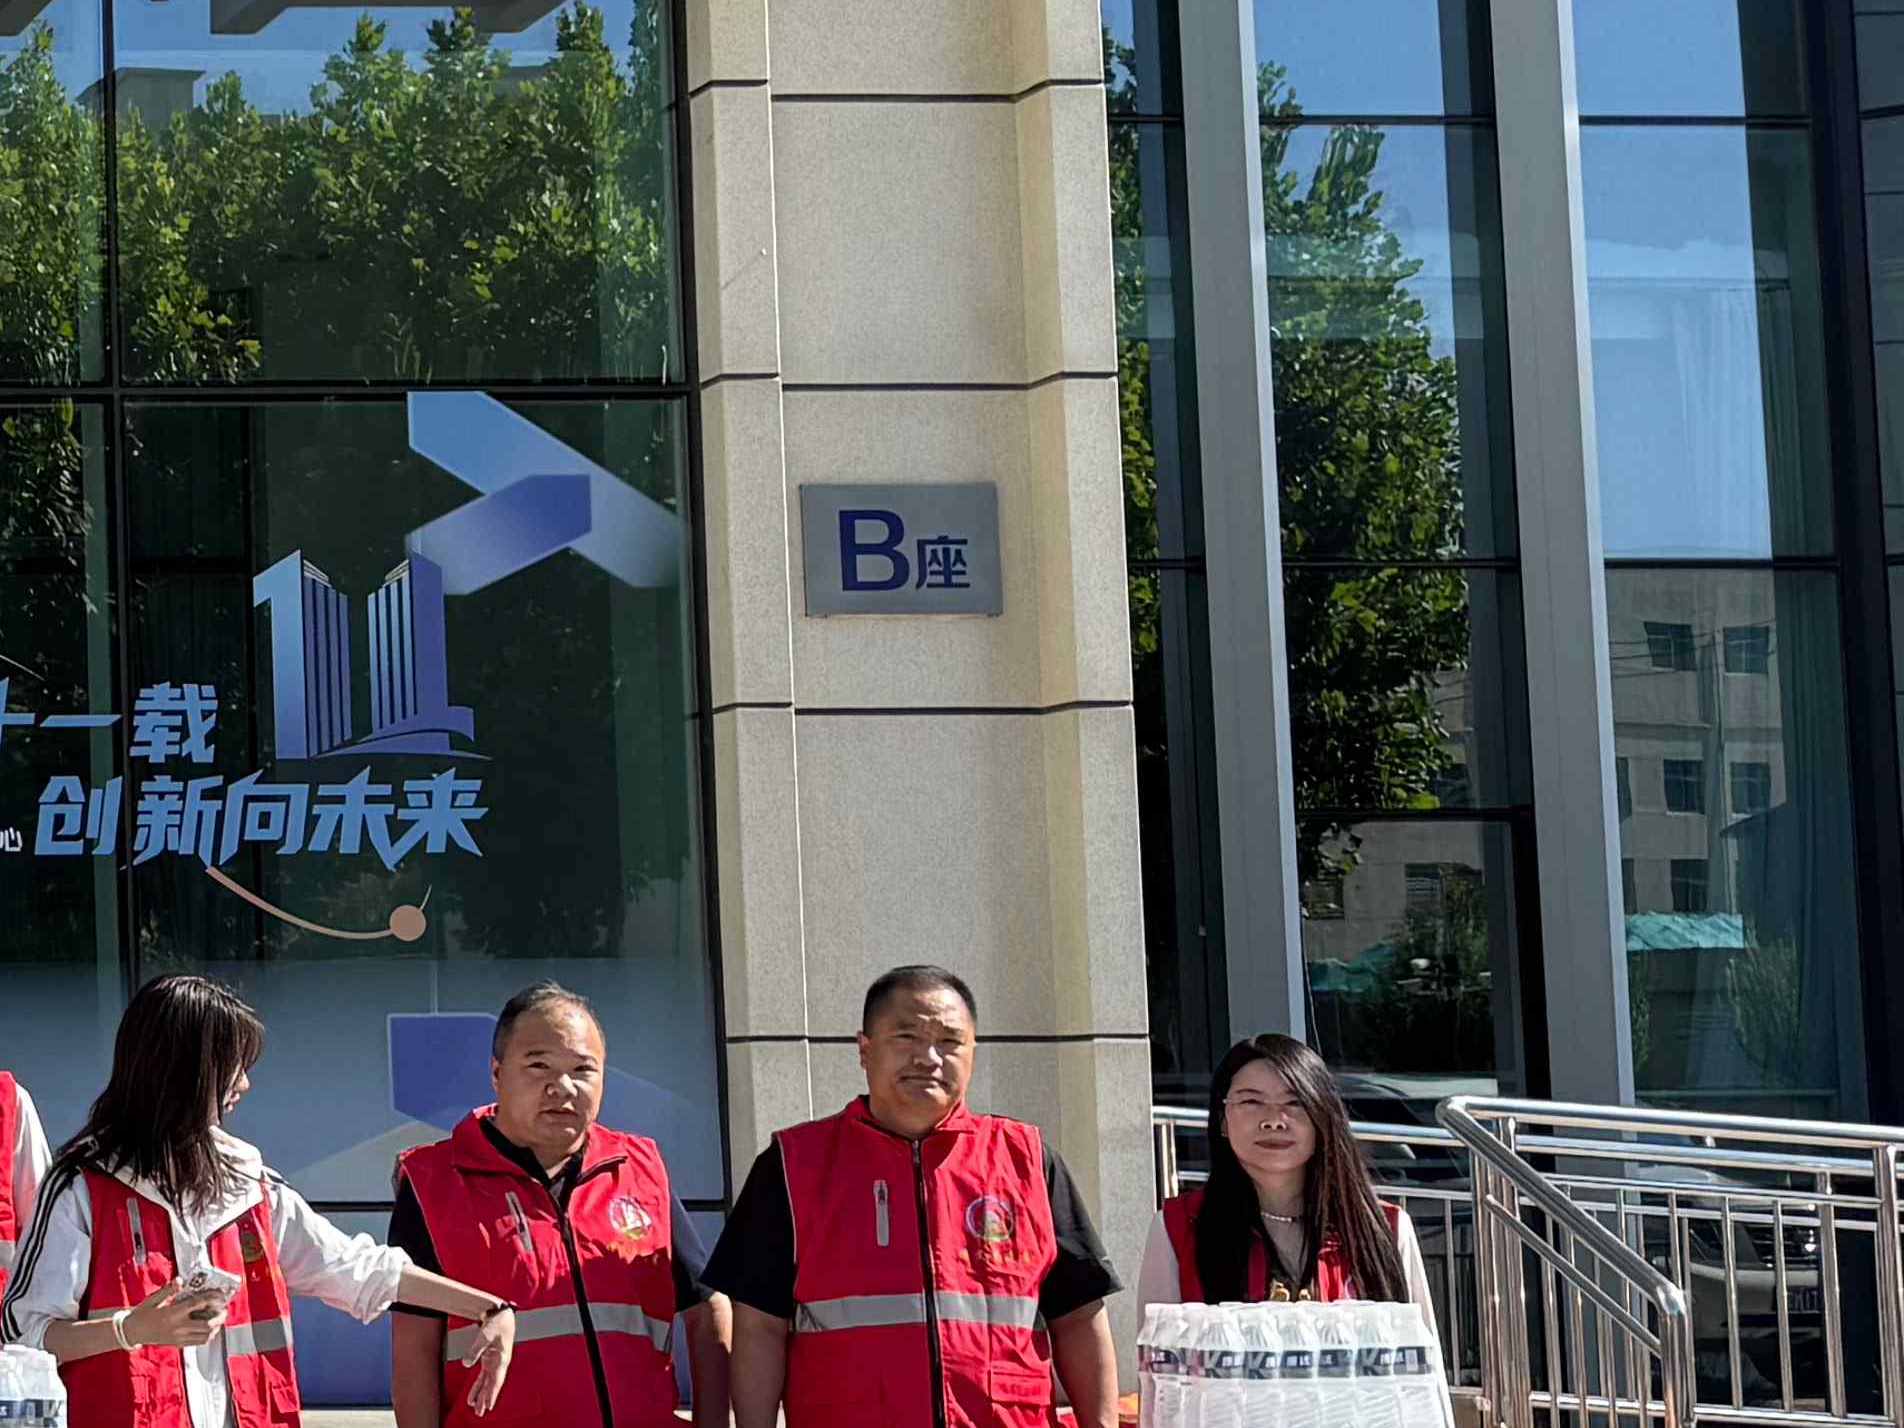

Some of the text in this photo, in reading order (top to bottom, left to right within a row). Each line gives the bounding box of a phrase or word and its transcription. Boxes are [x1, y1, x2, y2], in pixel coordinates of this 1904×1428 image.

[839, 509, 970, 590] B座
[34, 767, 489, 870] 创新向未来
